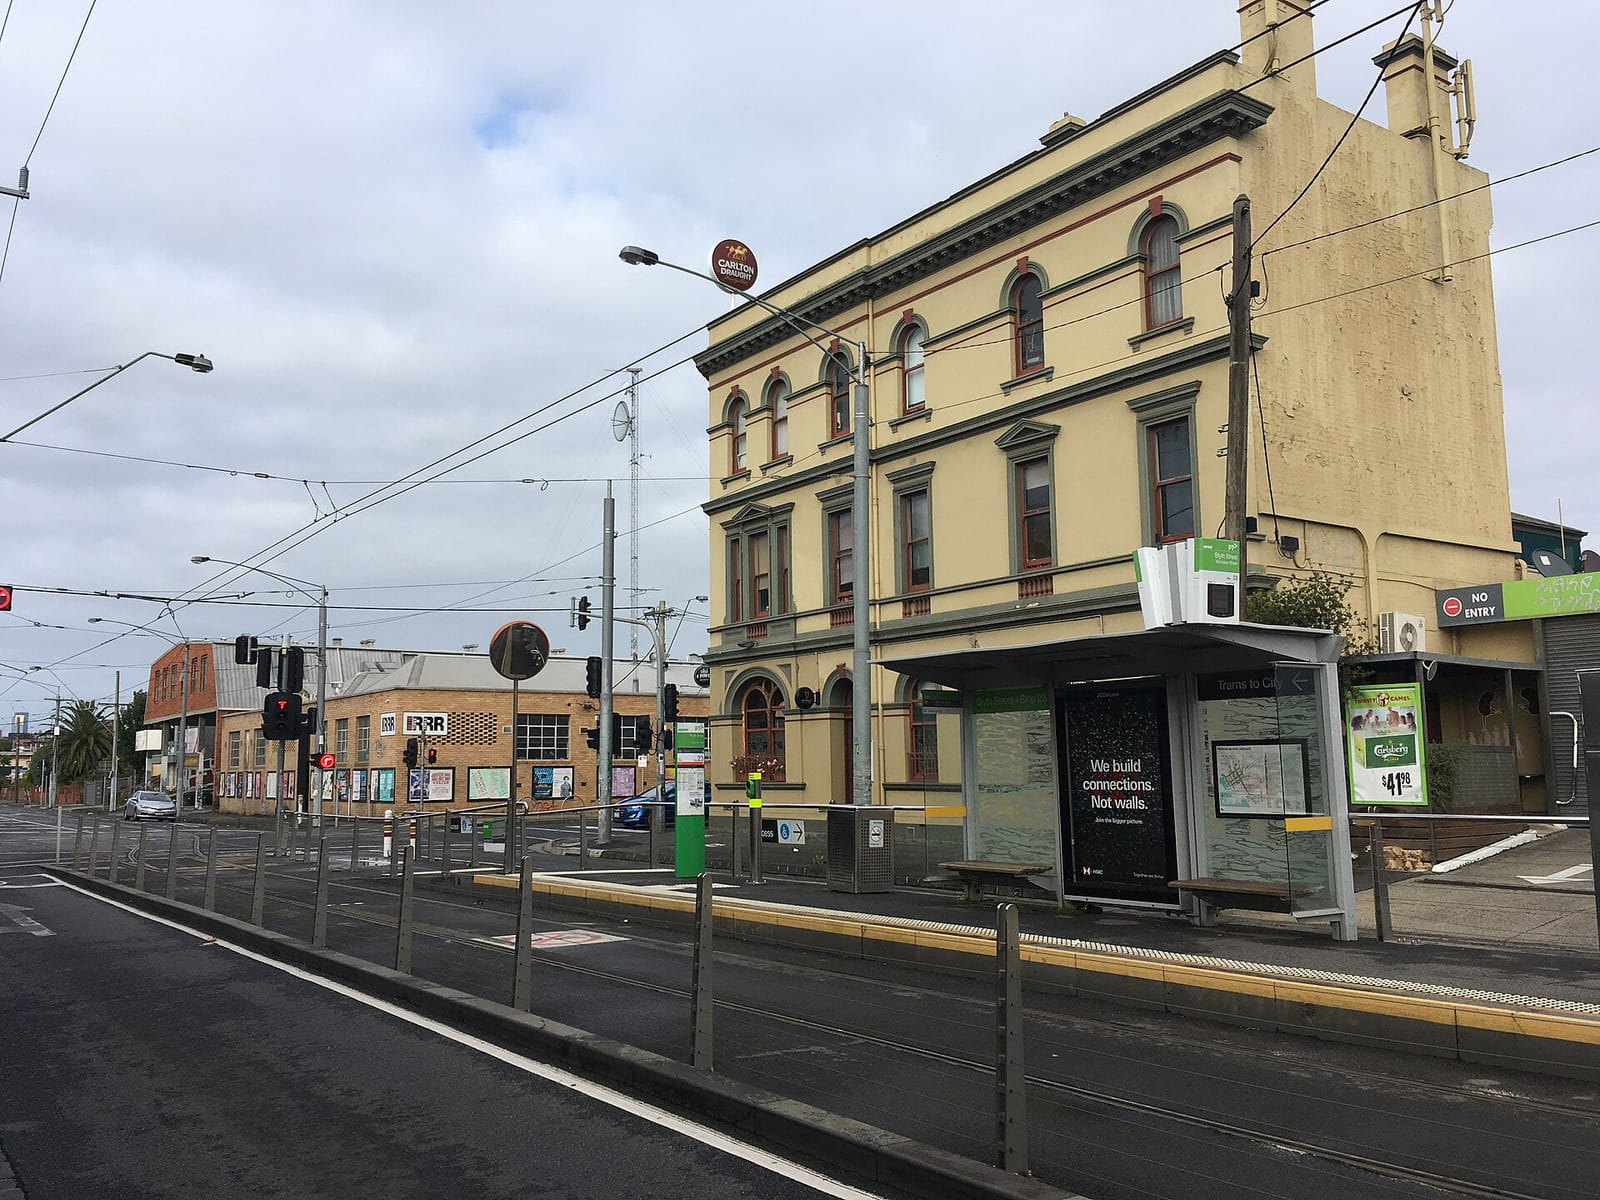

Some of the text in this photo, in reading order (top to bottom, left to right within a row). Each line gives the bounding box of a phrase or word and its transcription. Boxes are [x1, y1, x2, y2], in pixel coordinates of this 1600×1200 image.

[718, 259, 754, 275] CARLTON
[721, 267, 752, 280] DRAUGHT
[1471, 592, 1488, 603] NO
[1464, 606, 1496, 618] ENTRY
[1217, 676, 1282, 691] Trams to City
[1373, 743, 1408, 757] Carlsberg
[1090, 758, 1142, 772] We build
[1082, 777, 1155, 791] connections.
[1091, 794, 1148, 810] Not walls.
[760, 829, 774, 838] cess
